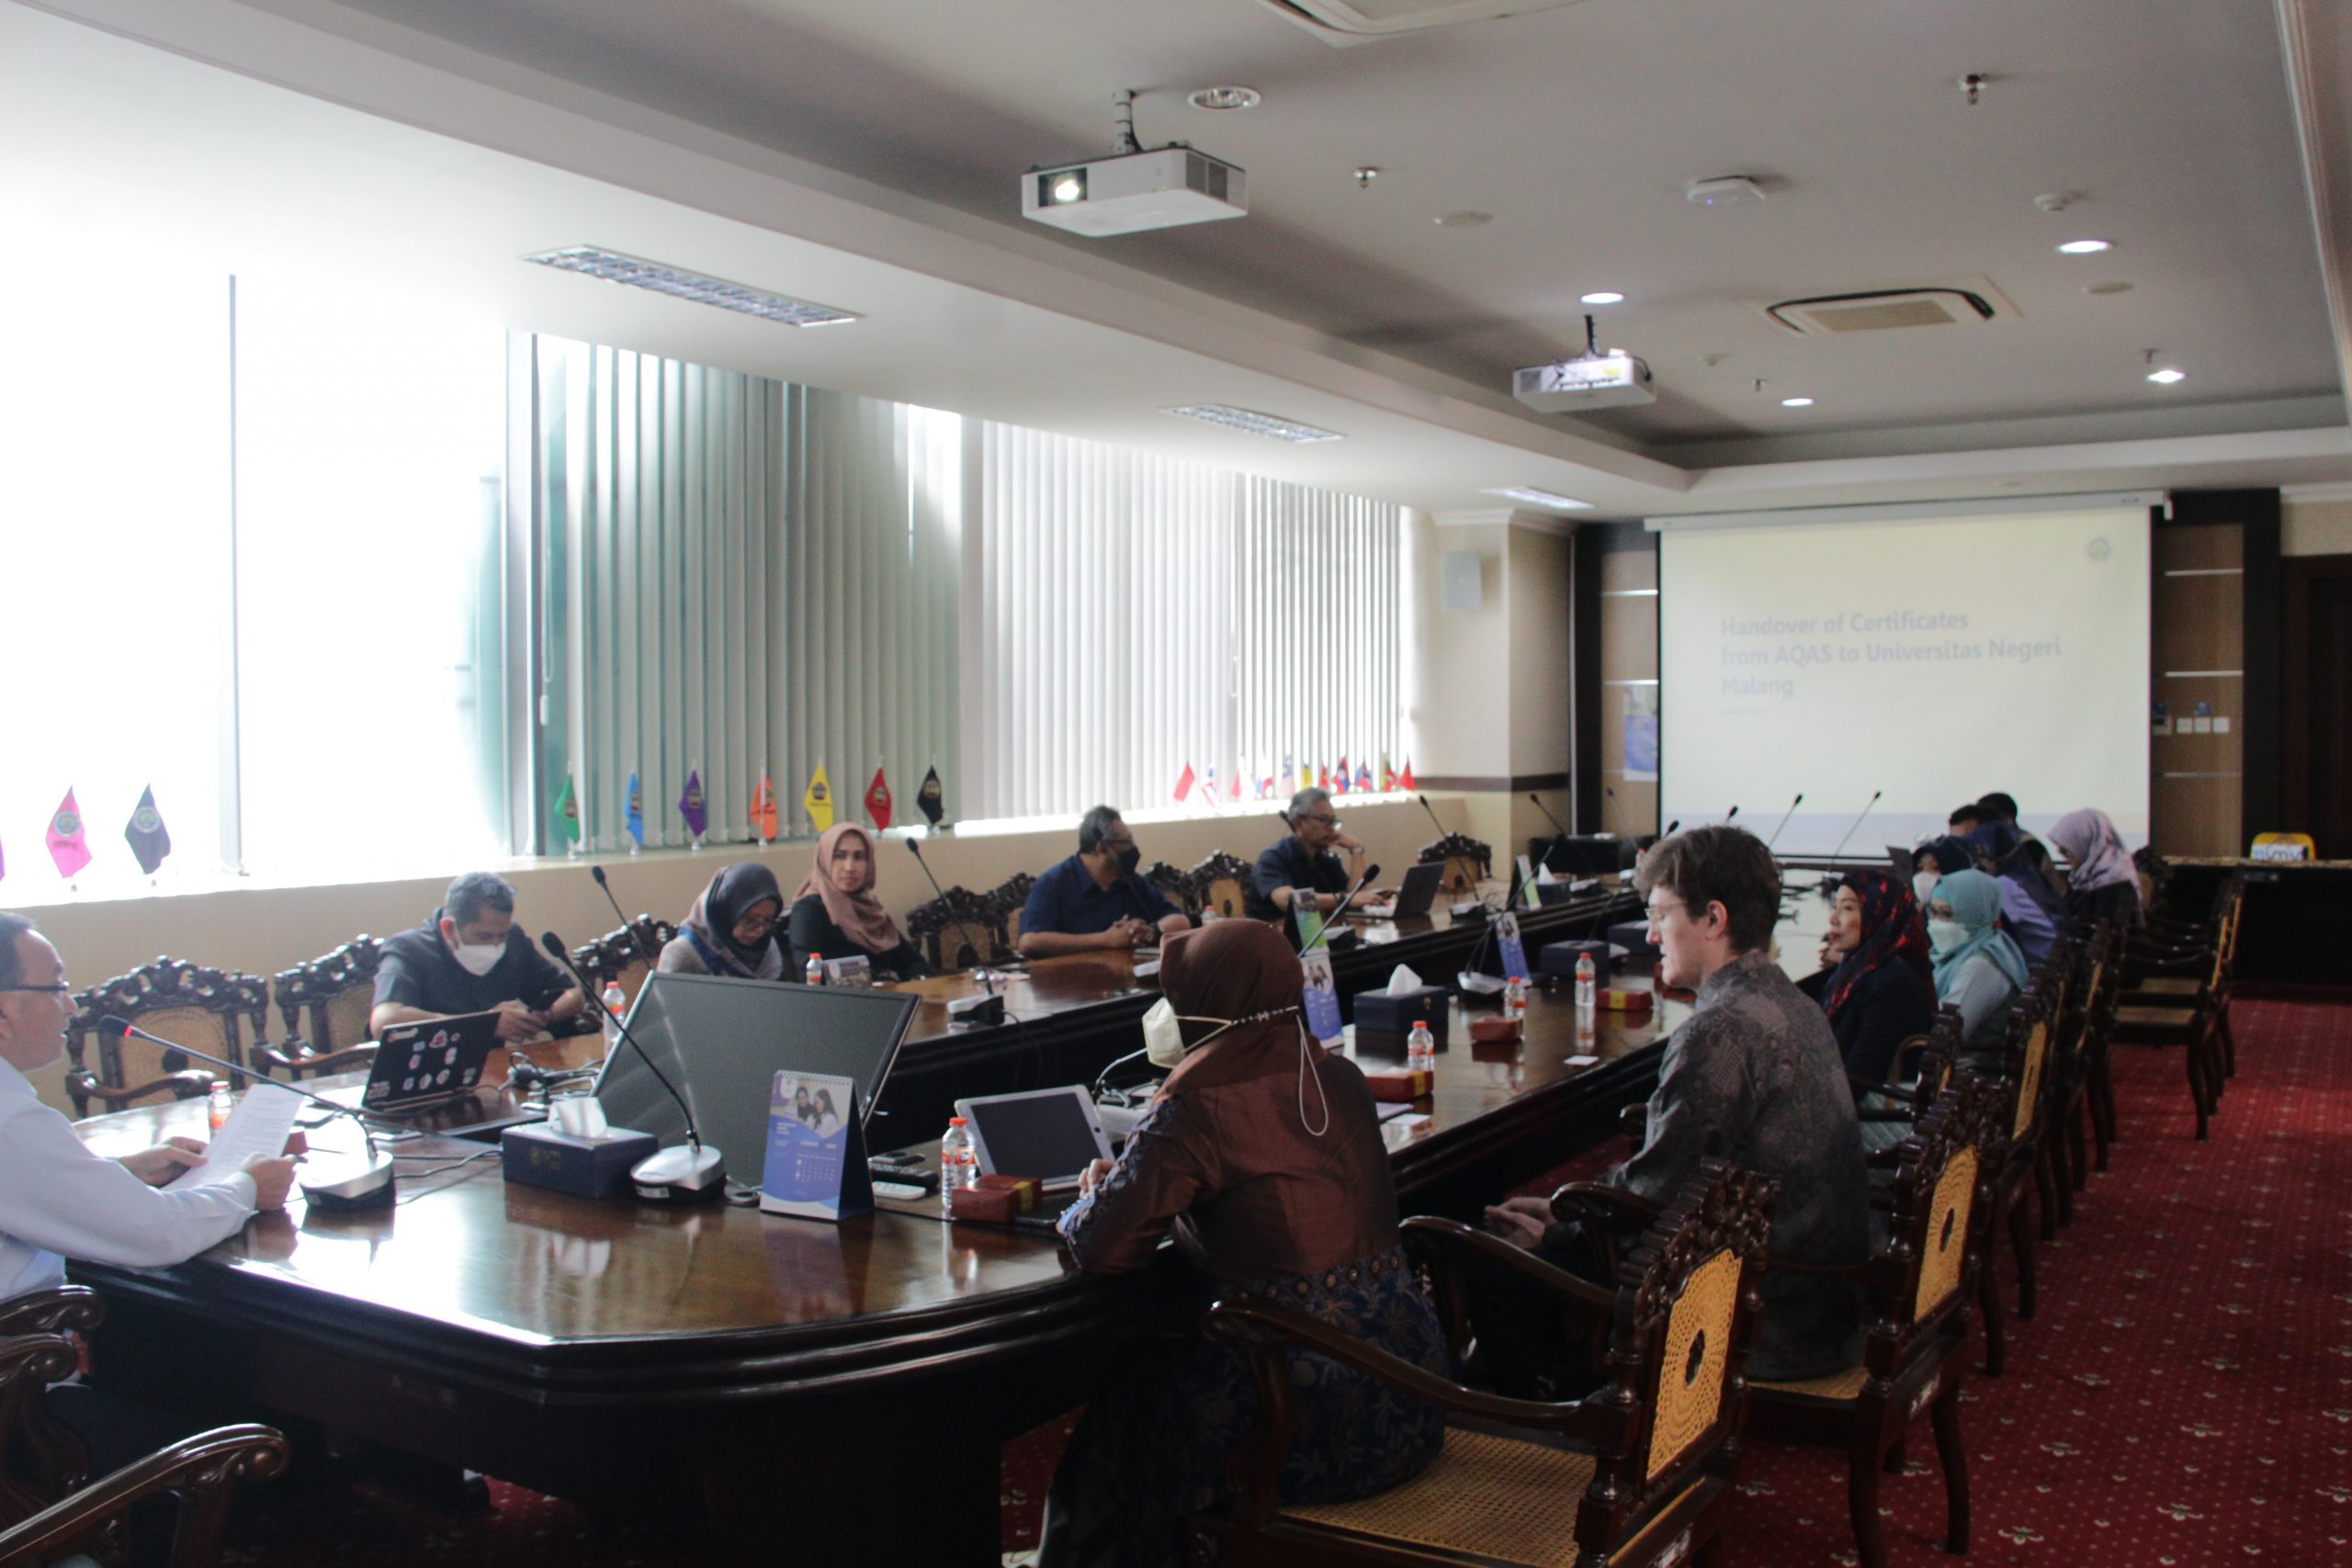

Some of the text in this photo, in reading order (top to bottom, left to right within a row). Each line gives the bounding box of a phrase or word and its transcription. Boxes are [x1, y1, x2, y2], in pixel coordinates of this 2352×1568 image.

[1721, 611, 1969, 636] Handover of Certificates
[1721, 636, 2063, 668] from AQAS to Universitas Negeri
[1721, 675, 1794, 700] Malang
